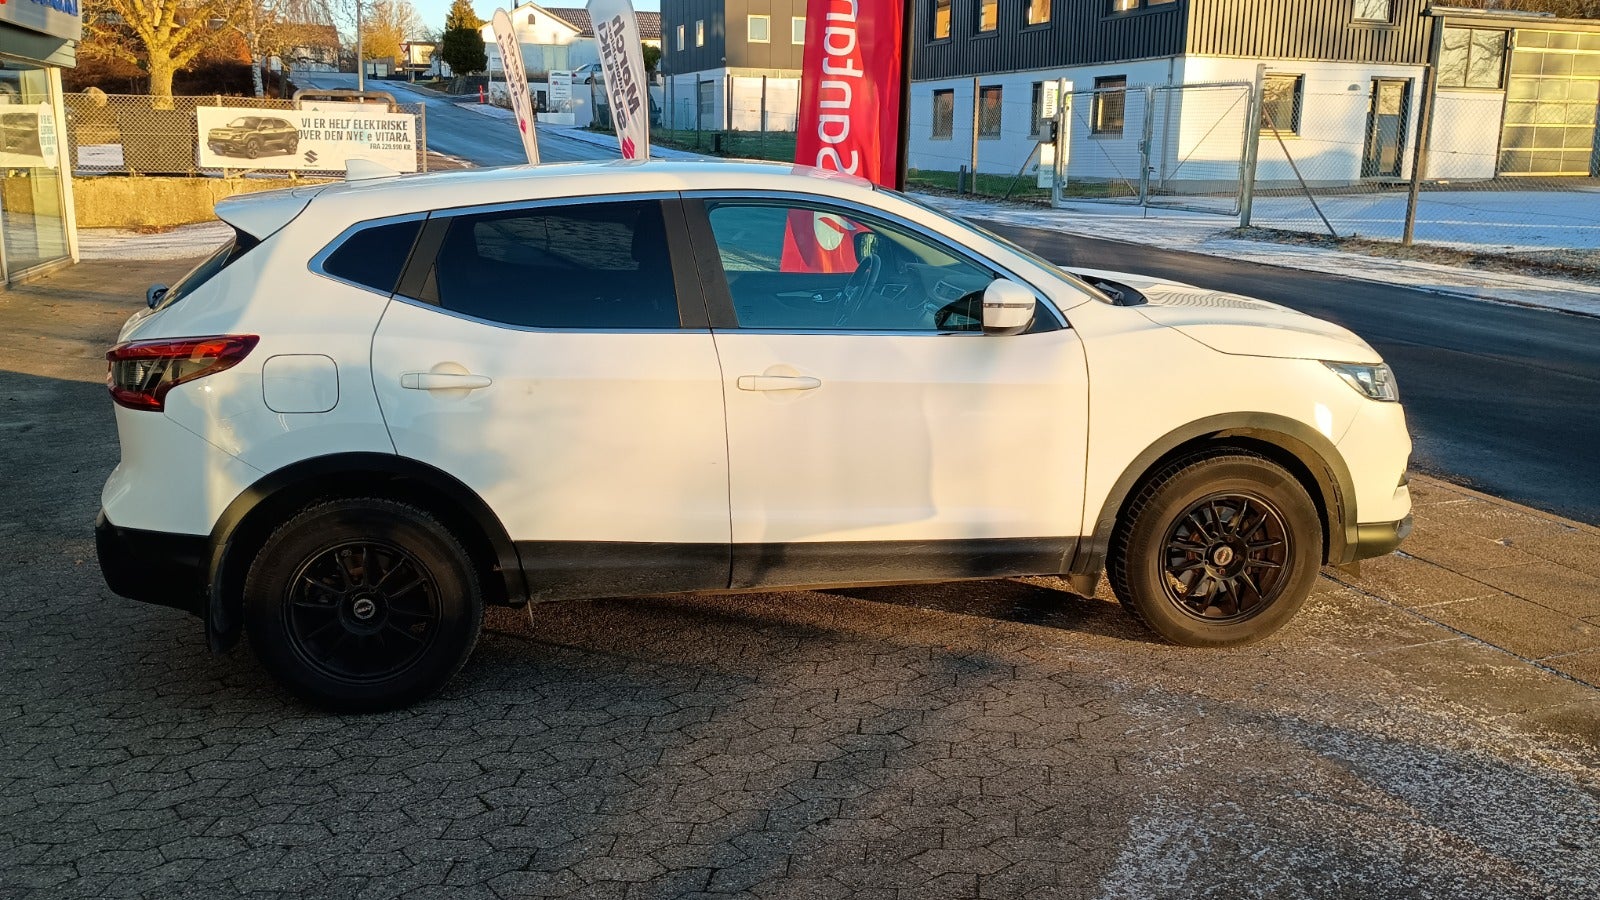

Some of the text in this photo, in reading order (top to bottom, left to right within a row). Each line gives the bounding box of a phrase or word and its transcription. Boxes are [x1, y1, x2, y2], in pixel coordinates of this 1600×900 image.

[301, 118, 408, 130] VI ER HELT ELEKTRISKE
[298, 130, 411, 143] OVER DEN NYE e VITARA.
